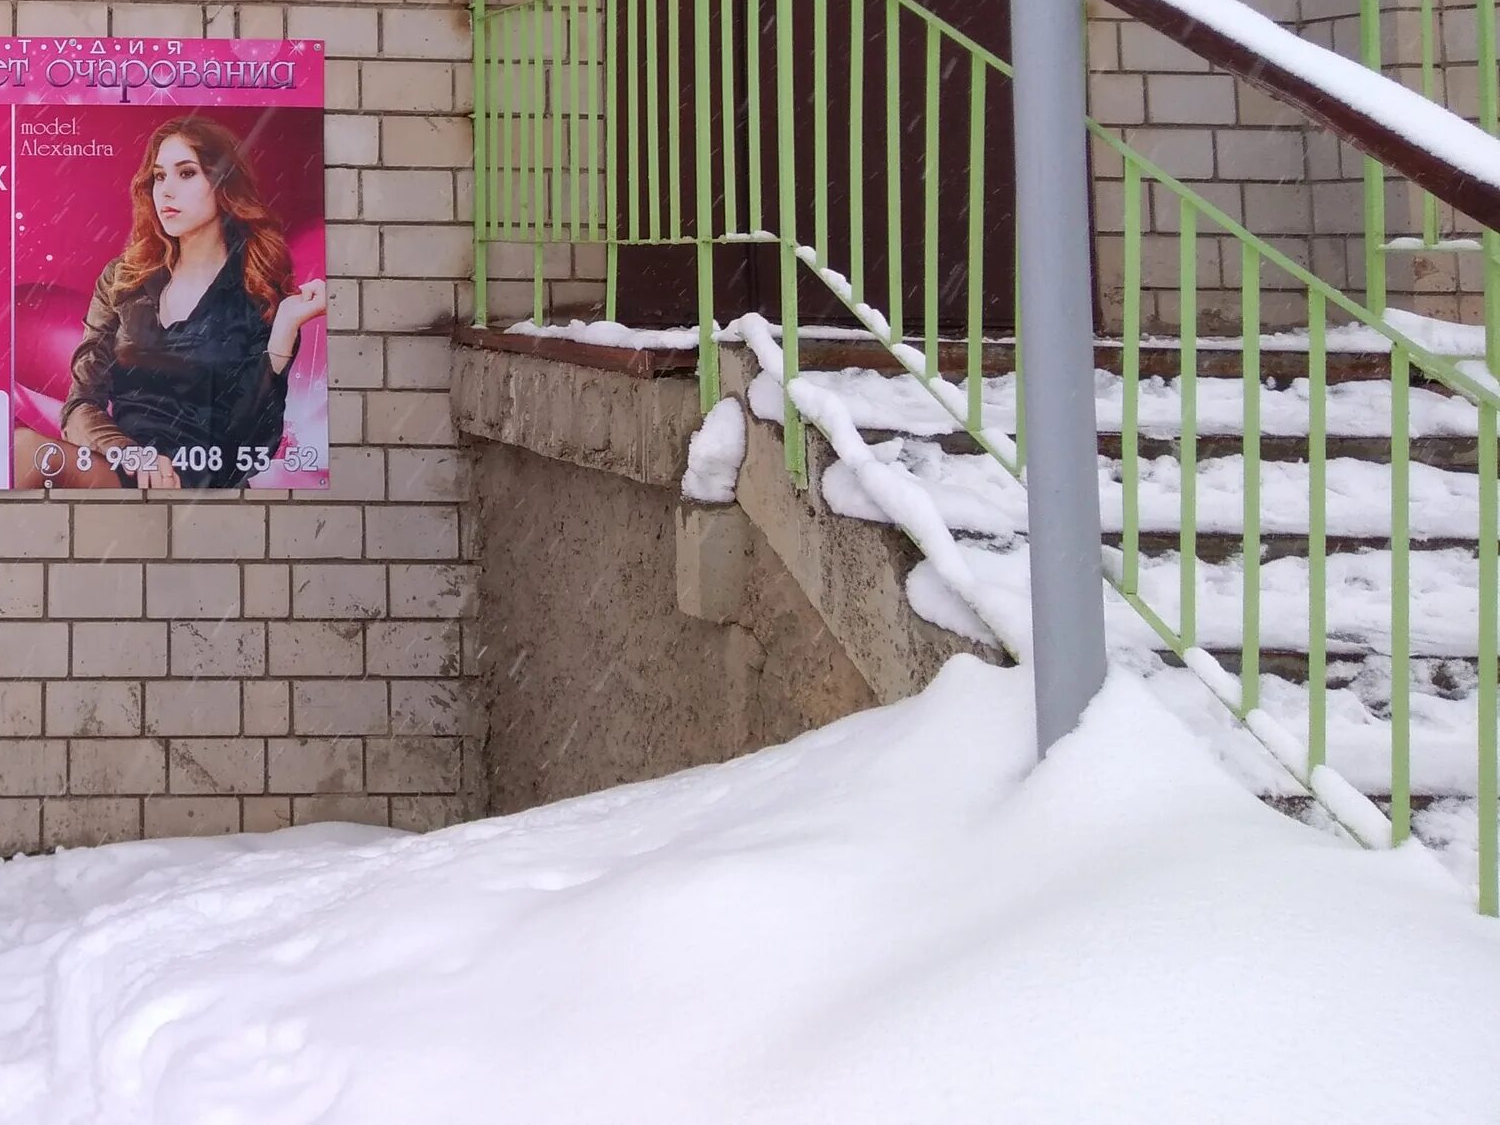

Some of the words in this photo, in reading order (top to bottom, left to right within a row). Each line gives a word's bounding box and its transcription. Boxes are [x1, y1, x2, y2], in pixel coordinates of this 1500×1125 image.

[45, 58, 297, 103] очарования
[20, 140, 115, 158] Alexandra
[76, 446, 92, 471] 8
[106, 446, 159, 472] 952
[172, 446, 223, 472] 408
[236, 446, 270, 472] 53
[283, 446, 319, 472] 52
